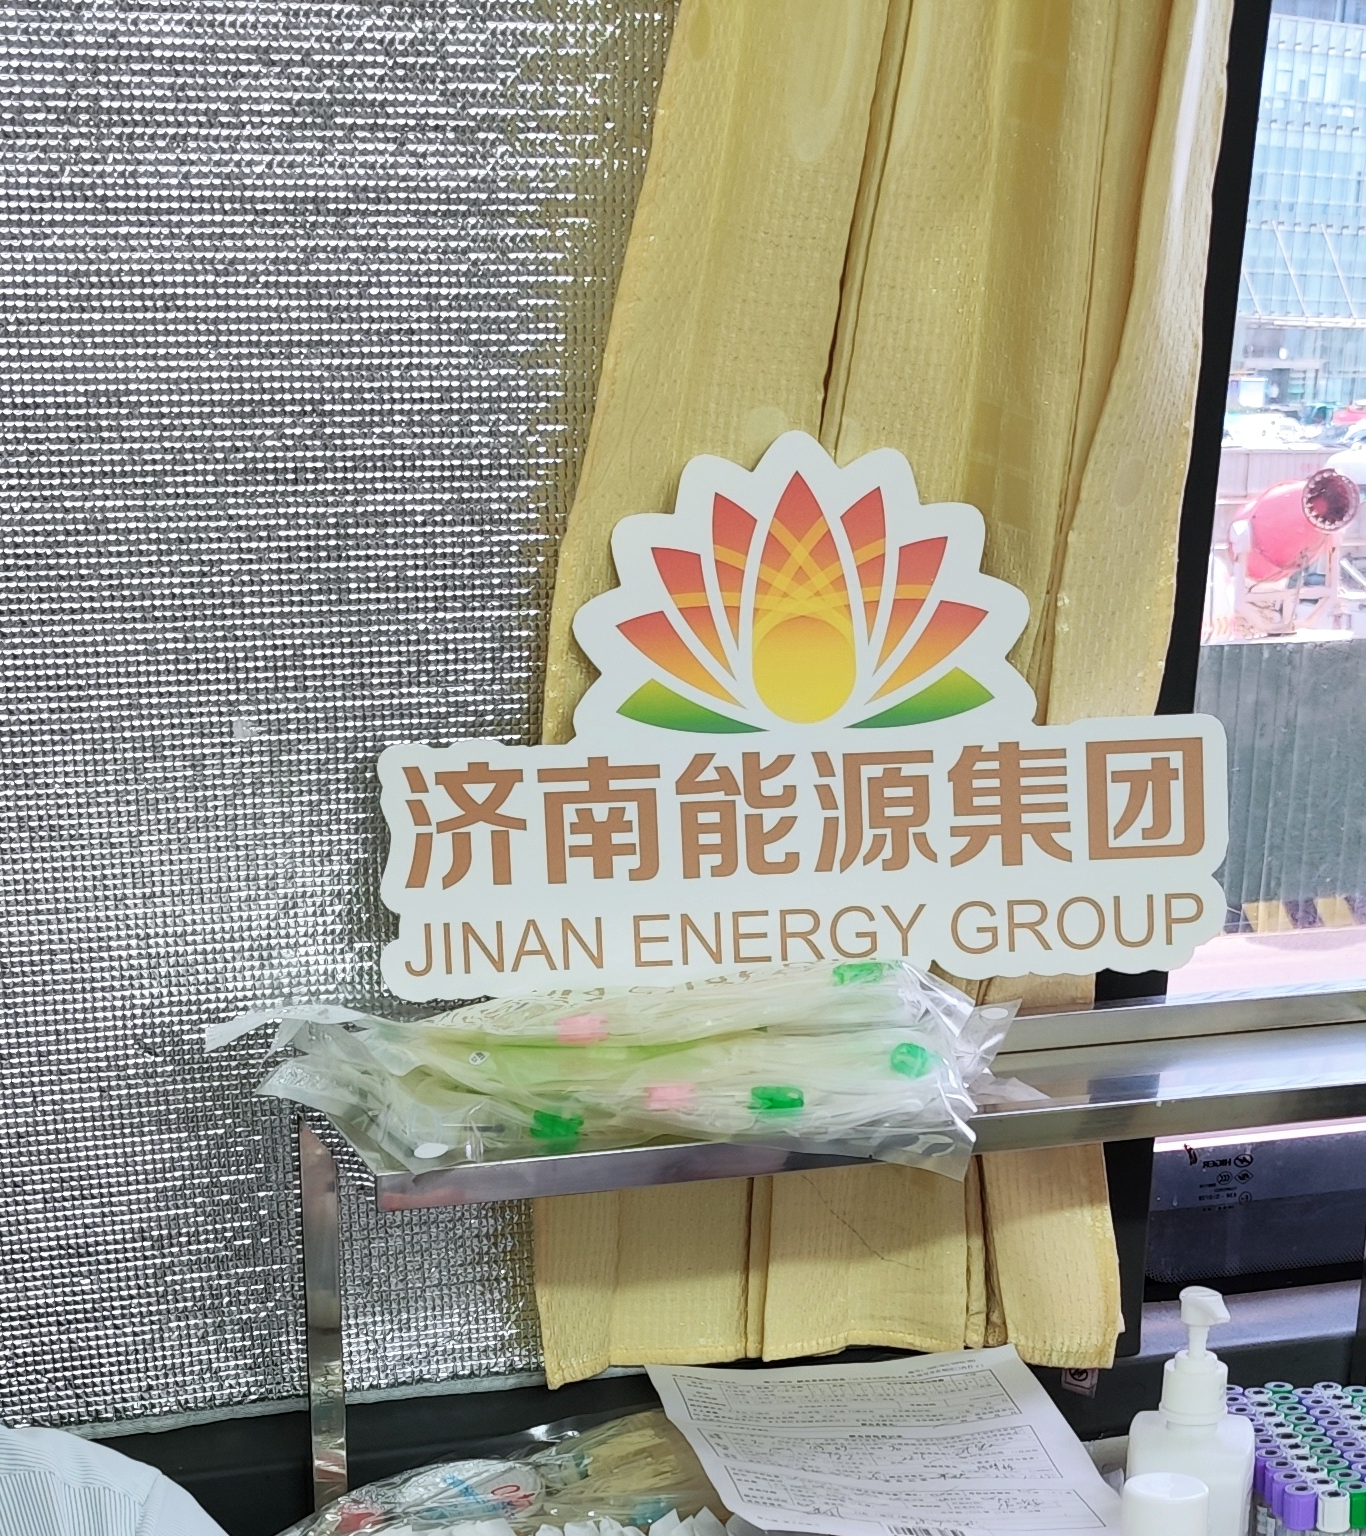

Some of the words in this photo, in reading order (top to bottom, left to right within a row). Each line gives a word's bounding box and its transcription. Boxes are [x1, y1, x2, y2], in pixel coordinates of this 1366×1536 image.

[403, 738, 1206, 890] 济南能源集团
[404, 916, 605, 978] JINAN
[633, 904, 928, 968] ENERGY
[949, 892, 1205, 956] GROUP
